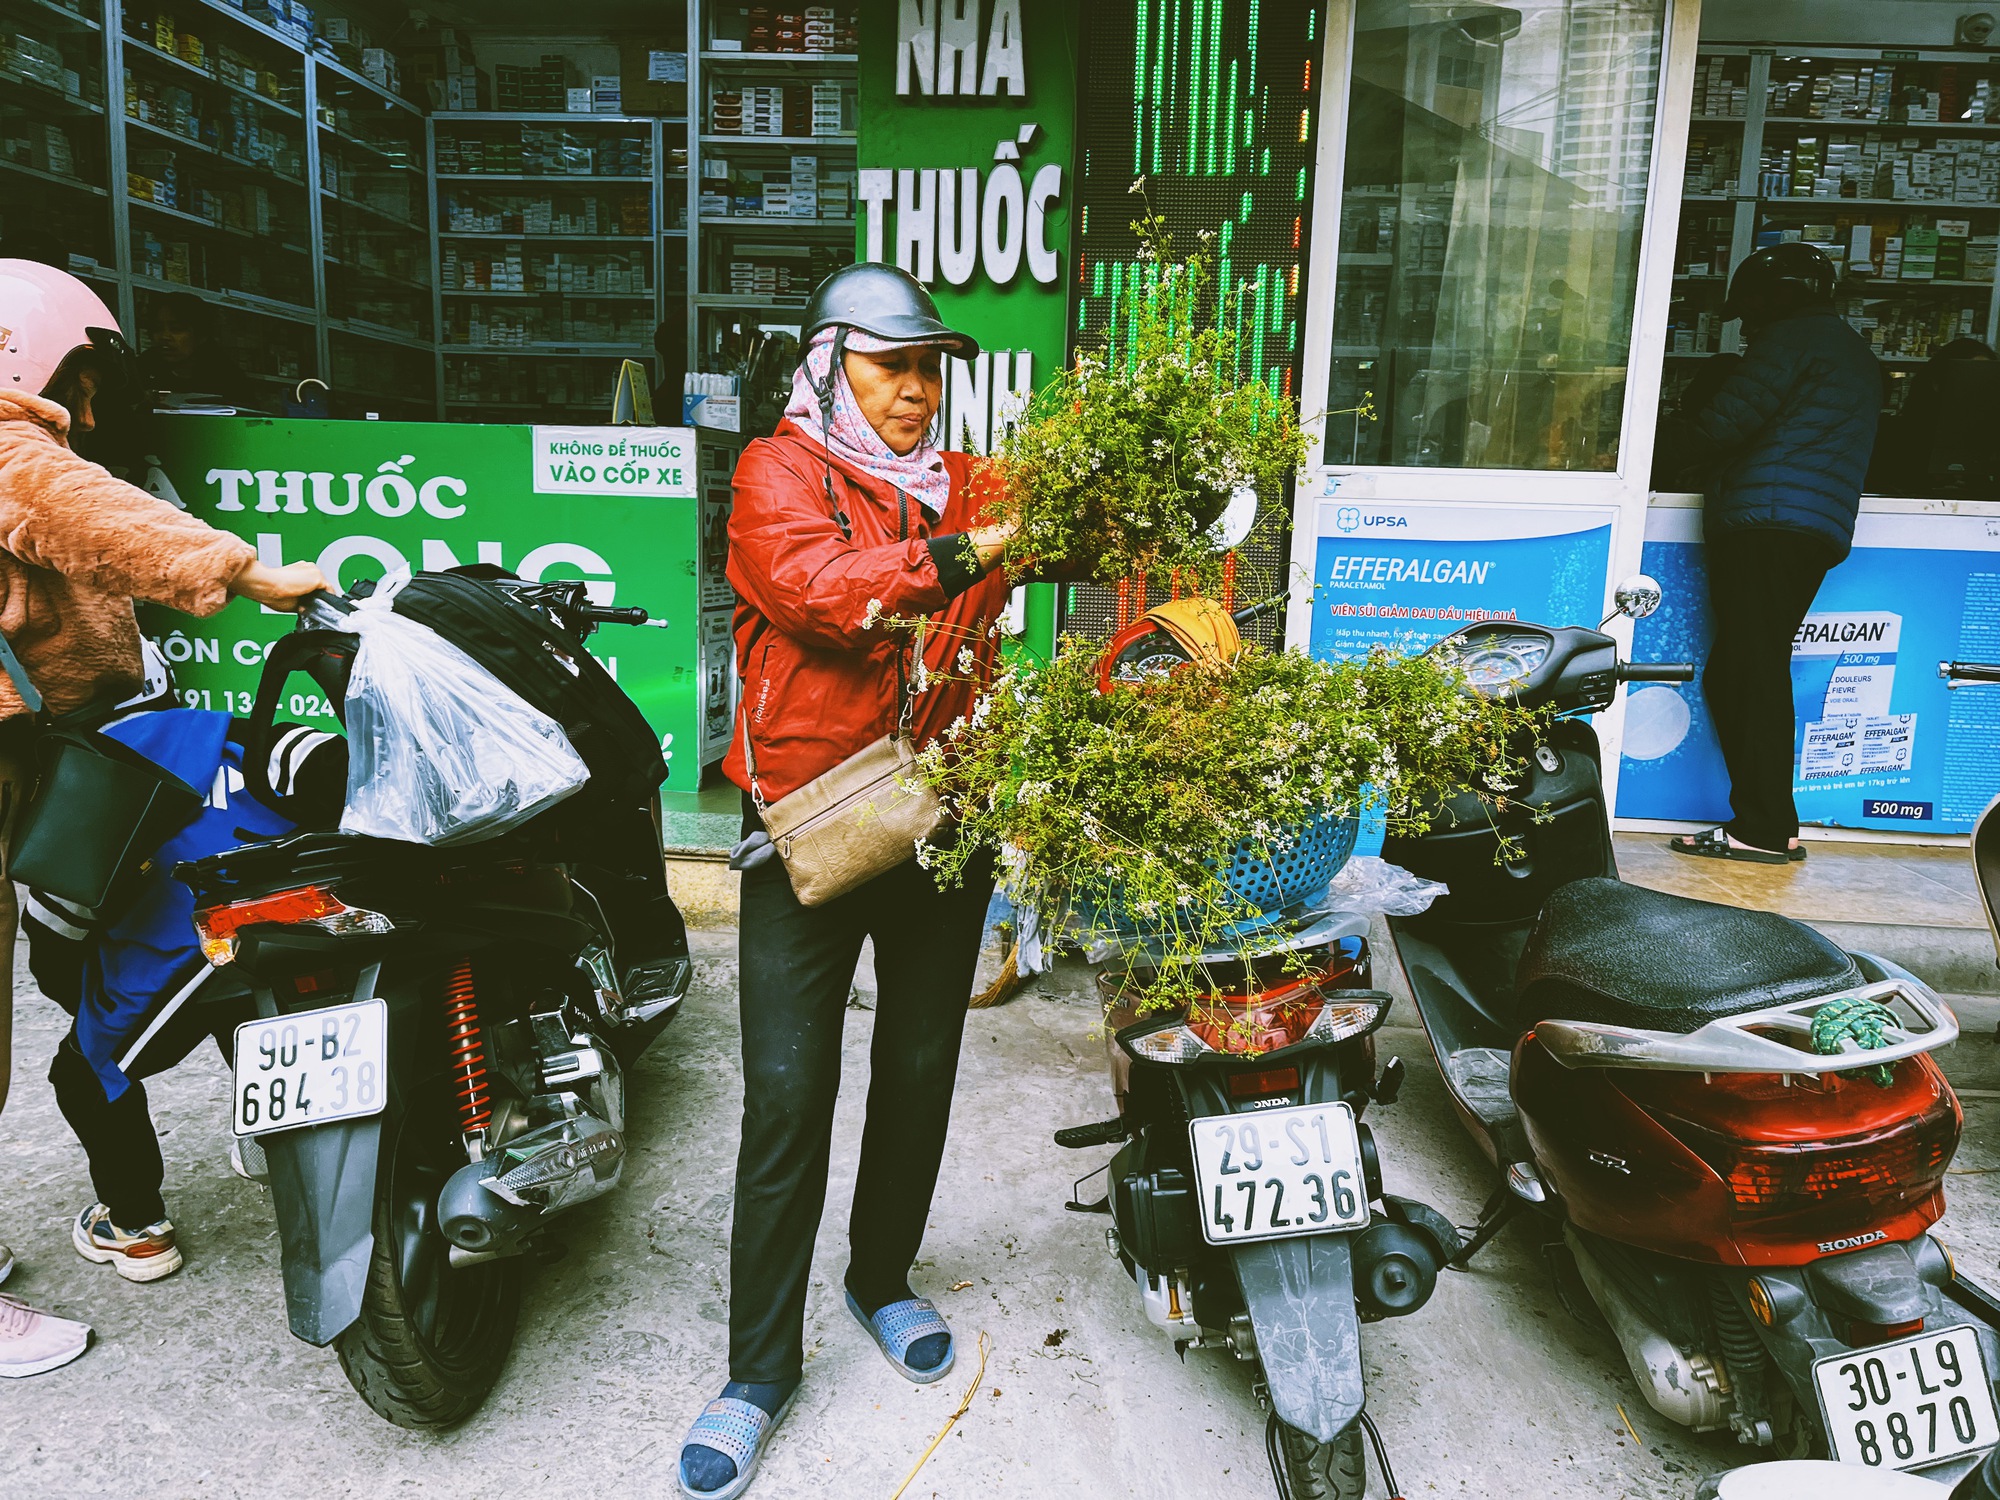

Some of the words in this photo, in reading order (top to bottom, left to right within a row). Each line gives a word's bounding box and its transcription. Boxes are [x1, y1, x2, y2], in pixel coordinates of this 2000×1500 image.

[858, 122, 1063, 285] THUỐC
[550, 440, 603, 456] KHÔNG
[608, 438, 626, 457] ĐỂ
[630, 441, 681, 458] THUỐC
[549, 460, 596, 483] VÀO
[603, 460, 650, 484] CỐP
[656, 467, 683, 485] XE
[205, 454, 468, 520] THUỐC
[1363, 516, 1408, 527] UPSA
[1330, 556, 1489, 585] EFFERALGAN
[1329, 581, 1386, 590] PARACETAMOL
[1331, 603, 1356, 617] VIÊN
[1359, 602, 1376, 618] SỦI
[1379, 603, 1409, 619] GIẢM
[1411, 607, 1435, 620] ĐAU
[1438, 605, 1462, 620] ĐẦU
[1794, 622, 1885, 643] ERALGAN
[1843, 654, 1863, 664] 500
[1864, 655, 1880, 665] mg
[1834, 675, 1872, 683] DOULEURS
[1809, 732, 1854, 742] EFFERALGAN
[1864, 727, 1907, 737] EFFERALGAN
[1871, 802, 1898, 815] 500
[1899, 805, 1923, 818] mg
[258, 1013, 361, 1071] 90-B2
[242, 1061, 376, 1127] 684.38
[1215, 1114, 1332, 1176] 29-S1
[1214, 1169, 1356, 1233] 472.36
[1817, 1230, 1888, 1253] HONDA
[1839, 1339, 1963, 1412] 30-L9
[1854, 1395, 1977, 1467] 8870
